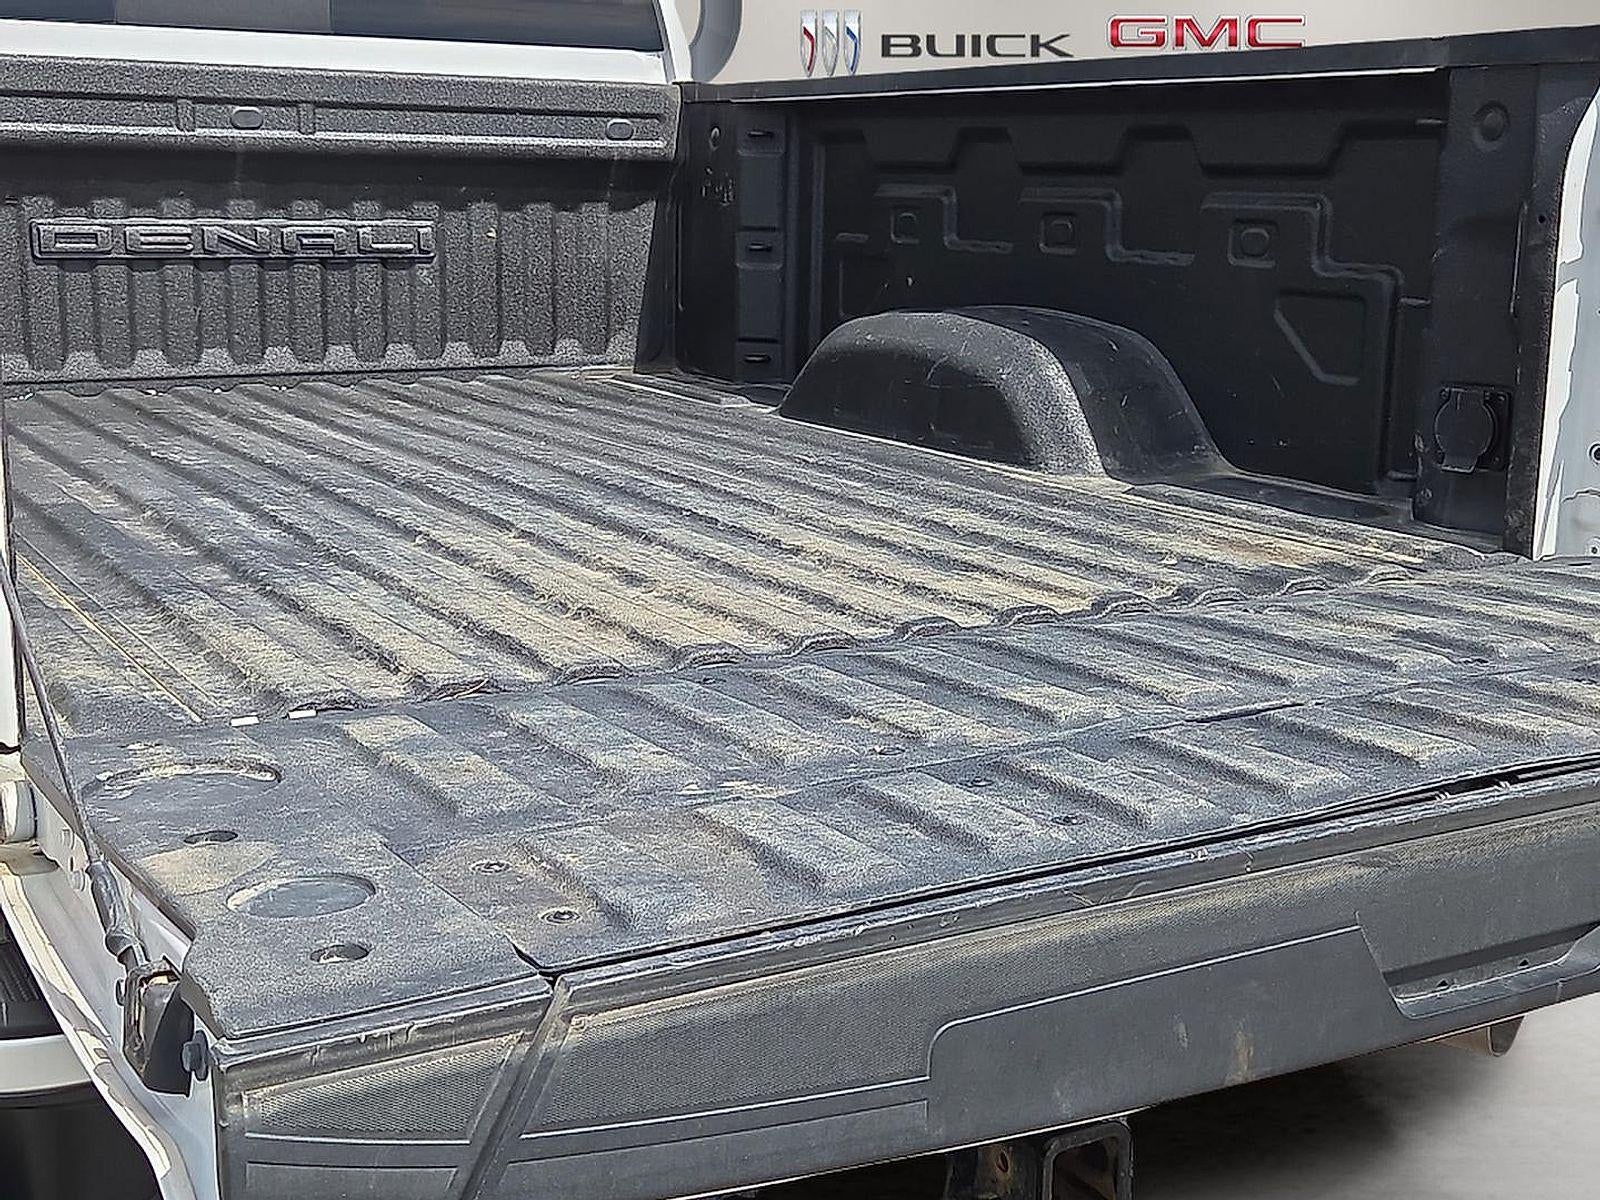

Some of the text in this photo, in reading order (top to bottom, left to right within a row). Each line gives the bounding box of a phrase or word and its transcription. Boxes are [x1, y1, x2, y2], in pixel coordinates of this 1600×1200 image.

[881, 14, 1305, 58] BUICK GMC
[37, 223, 433, 257] DENALI
